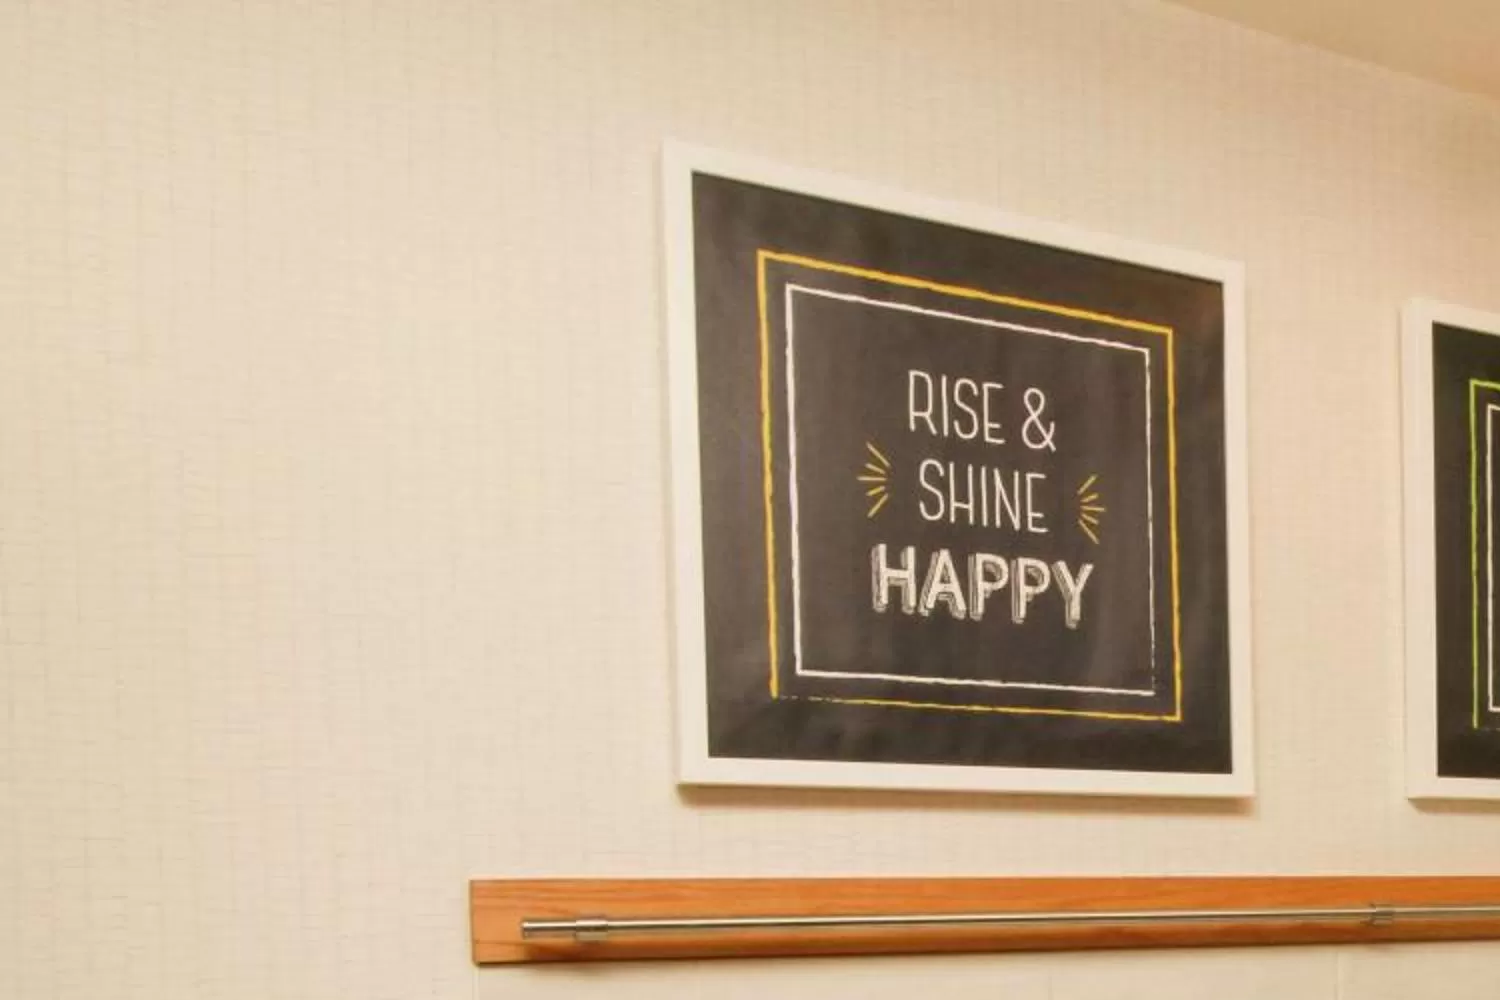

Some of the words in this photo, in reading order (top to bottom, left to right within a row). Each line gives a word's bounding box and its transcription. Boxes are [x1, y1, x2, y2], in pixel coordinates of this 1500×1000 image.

[908, 369, 1006, 445] RISE
[1021, 386, 1057, 453] &
[918, 458, 1049, 534] SHINE
[870, 542, 1095, 631] HAPPY
